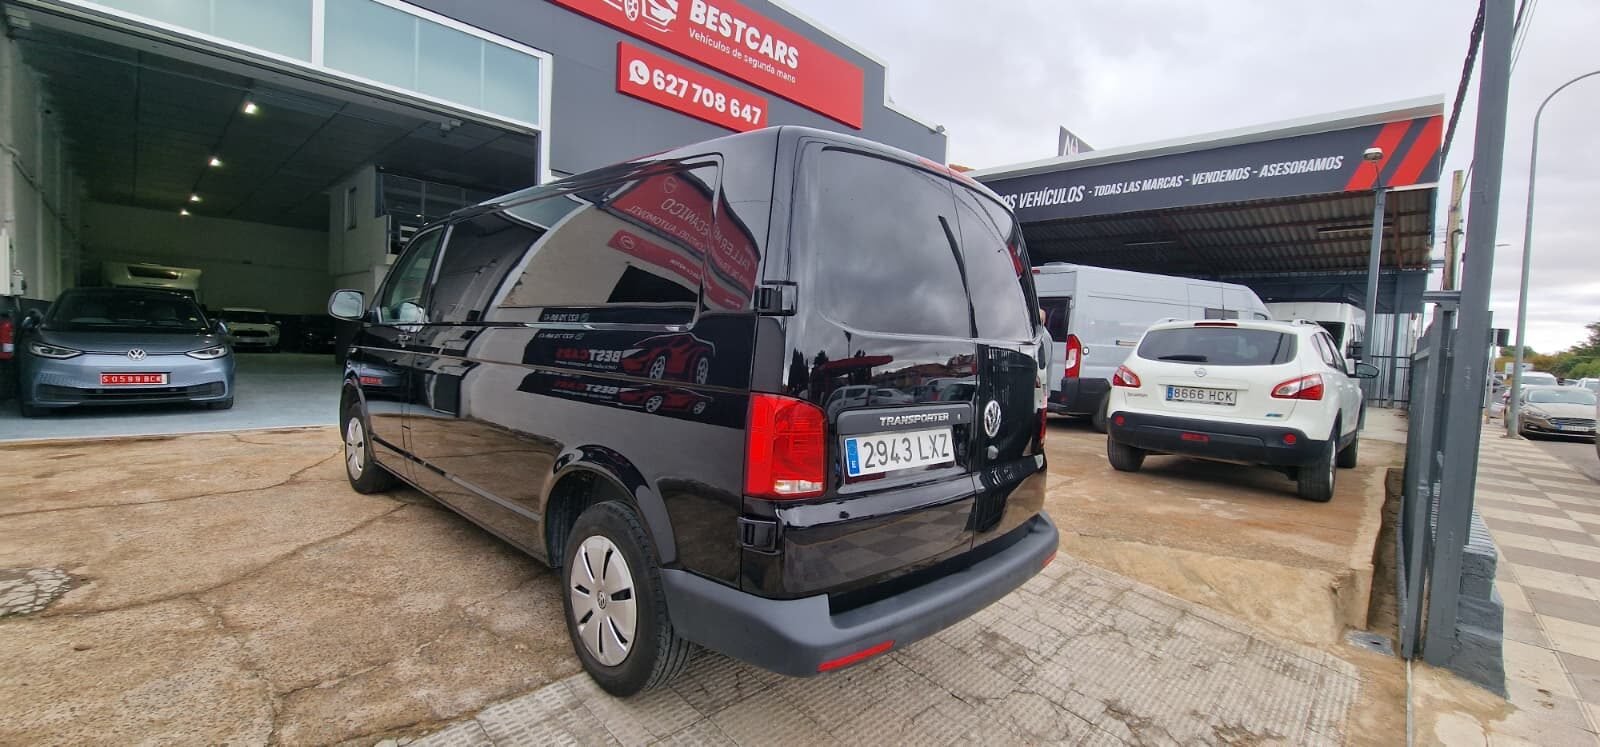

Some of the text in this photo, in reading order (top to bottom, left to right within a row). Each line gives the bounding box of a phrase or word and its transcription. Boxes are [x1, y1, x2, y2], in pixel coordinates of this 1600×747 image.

[689, 0, 799, 69] BESTCARS
[689, 27, 796, 84] Vehículos de segunda mano
[653, 69, 762, 125] 627 708 647
[1019, 186, 1086, 208] VEHÍCULOS
[1094, 181, 1122, 196] TODAS
[1123, 180, 1141, 193] LAS
[1142, 175, 1184, 191] MARCAS
[1192, 166, 1251, 186] VENDEMOS
[1259, 155, 1345, 178] ASESORAMOS
[880, 412, 950, 426] TRANSPORTER
[1174, 388, 1234, 402] 8666 HCK
[863, 437, 913, 469] 2943
[918, 433, 950, 460] LXZ
